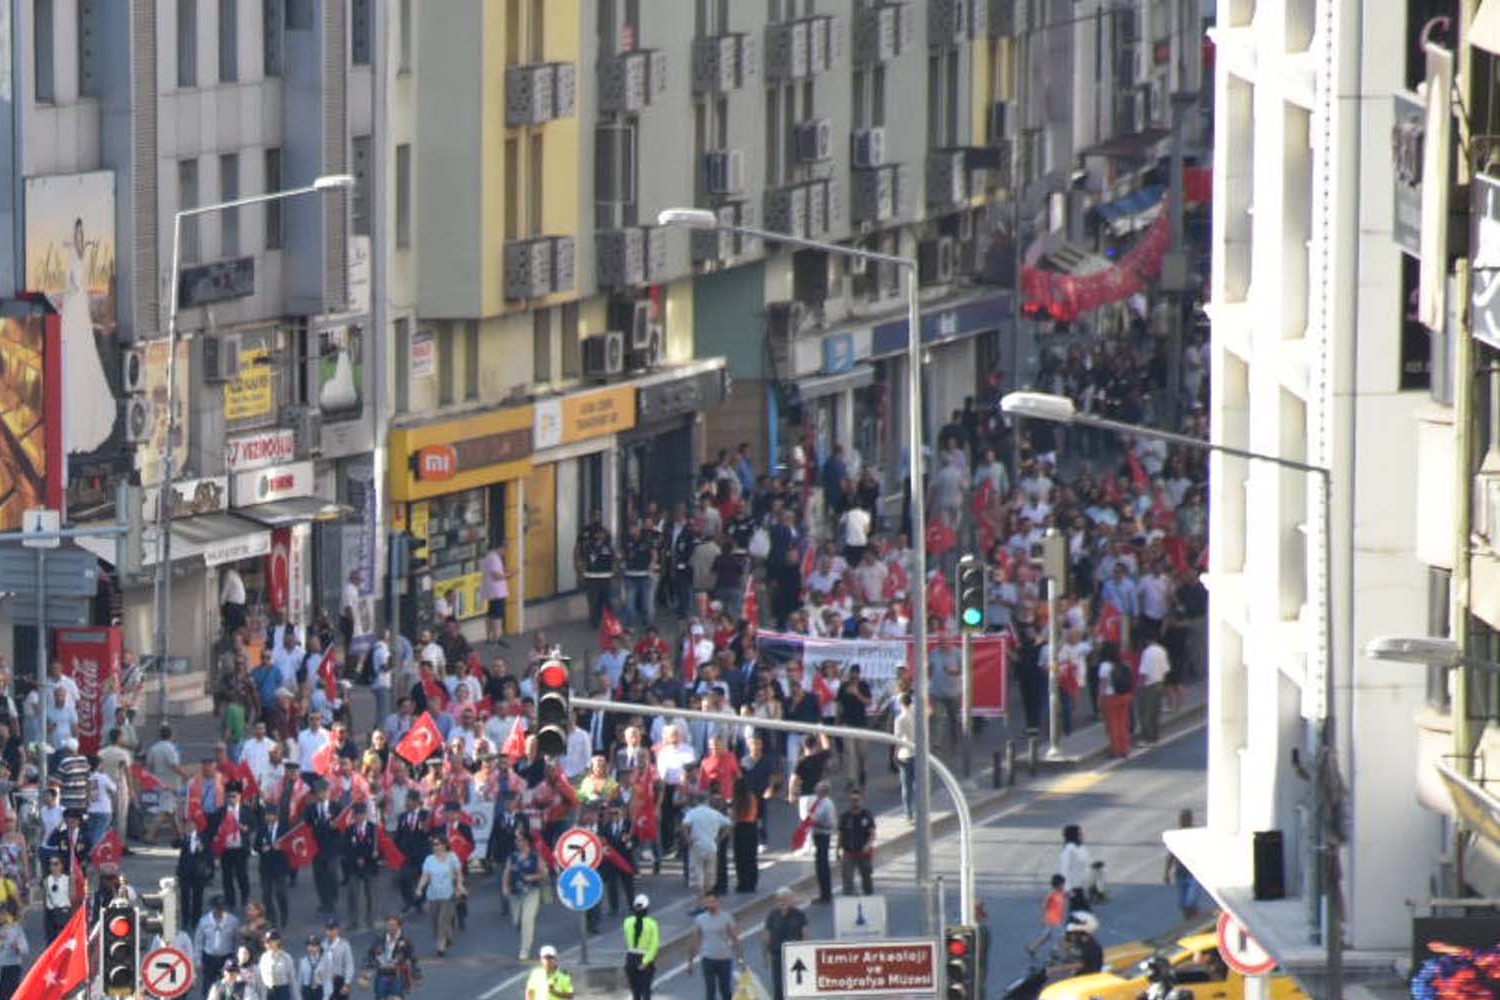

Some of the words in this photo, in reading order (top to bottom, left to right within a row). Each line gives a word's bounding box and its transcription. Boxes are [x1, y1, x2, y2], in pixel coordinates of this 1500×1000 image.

[820, 948, 859, 965] İzmir
[862, 949, 927, 965] Arkeoloji
[866, 965, 882, 975] ve
[888, 973, 932, 985] Müzesi
